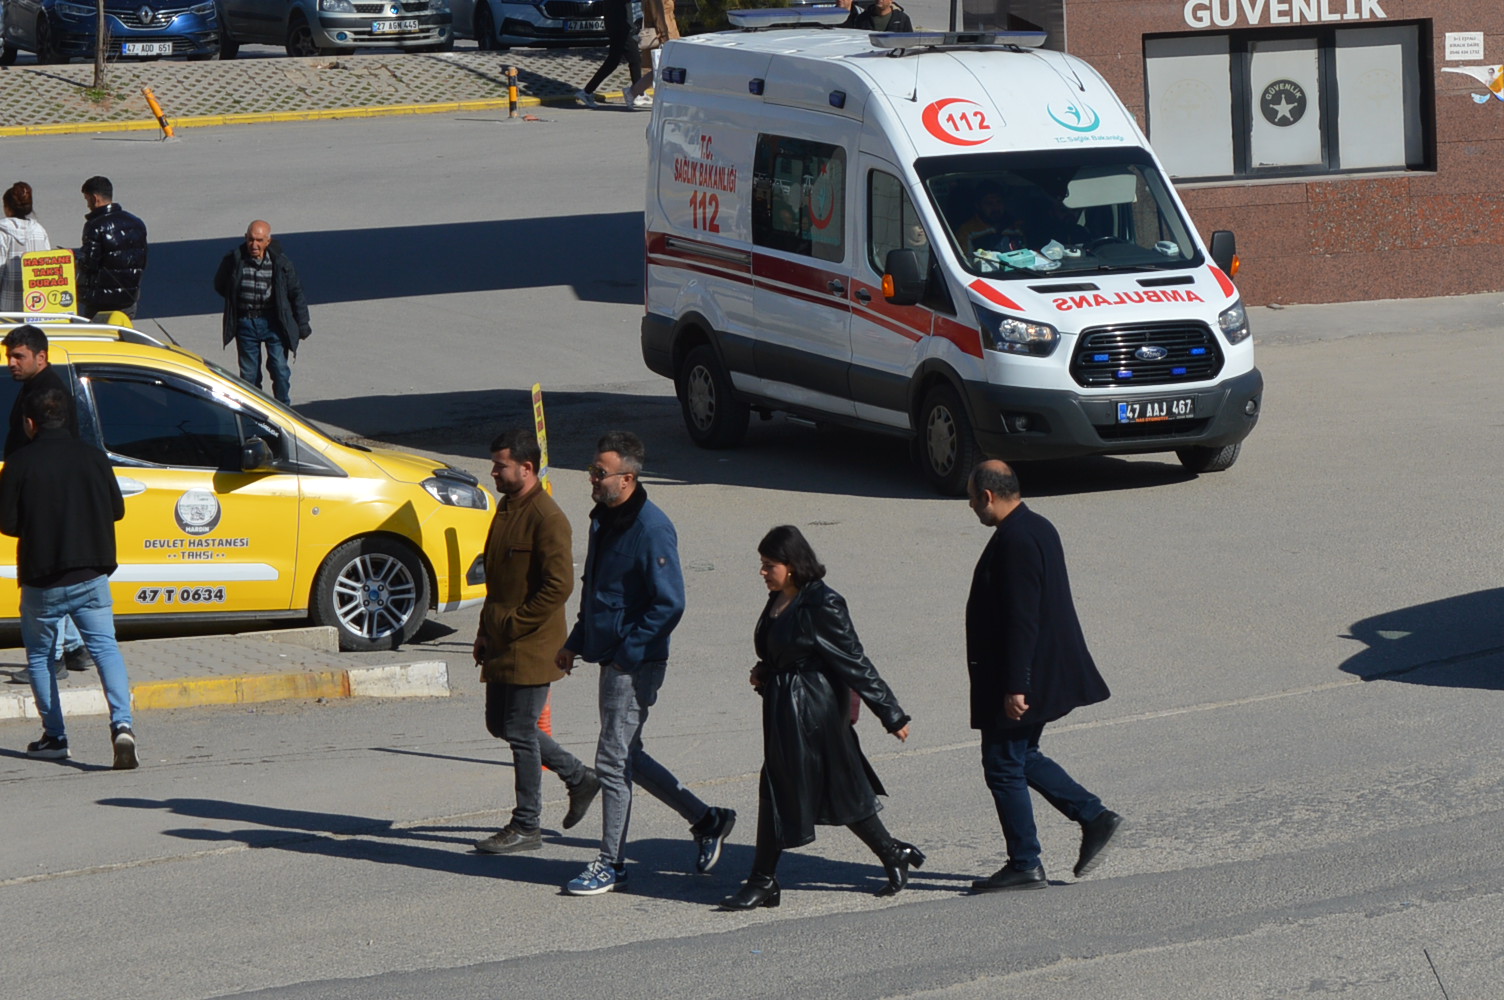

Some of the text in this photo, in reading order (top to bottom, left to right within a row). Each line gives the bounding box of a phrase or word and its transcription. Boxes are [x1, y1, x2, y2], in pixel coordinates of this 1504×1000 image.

[376, 21, 386, 31] 27
[404, 20, 418, 29] 445
[127, 43, 136, 52] 47
[158, 43, 171, 52] 651
[1265, 83, 1302, 100] GÜVENLİK
[946, 111, 990, 131] 112
[674, 155, 737, 193] SAĞLIK BAKANLIĞI
[689, 190, 720, 233] 112
[23, 255, 71, 267] HASTANE
[32, 264, 64, 277] TAKSİ
[29, 275, 68, 288] DURAĞI
[62, 293, 70, 301] 24
[1126, 405, 1139, 418] 47
[1146, 402, 1167, 417] AAJ
[1172, 400, 1192, 415] 467
[144, 538, 249, 548] DEVLET HASTANESİ
[137, 588, 224, 602] 47 T 0634
